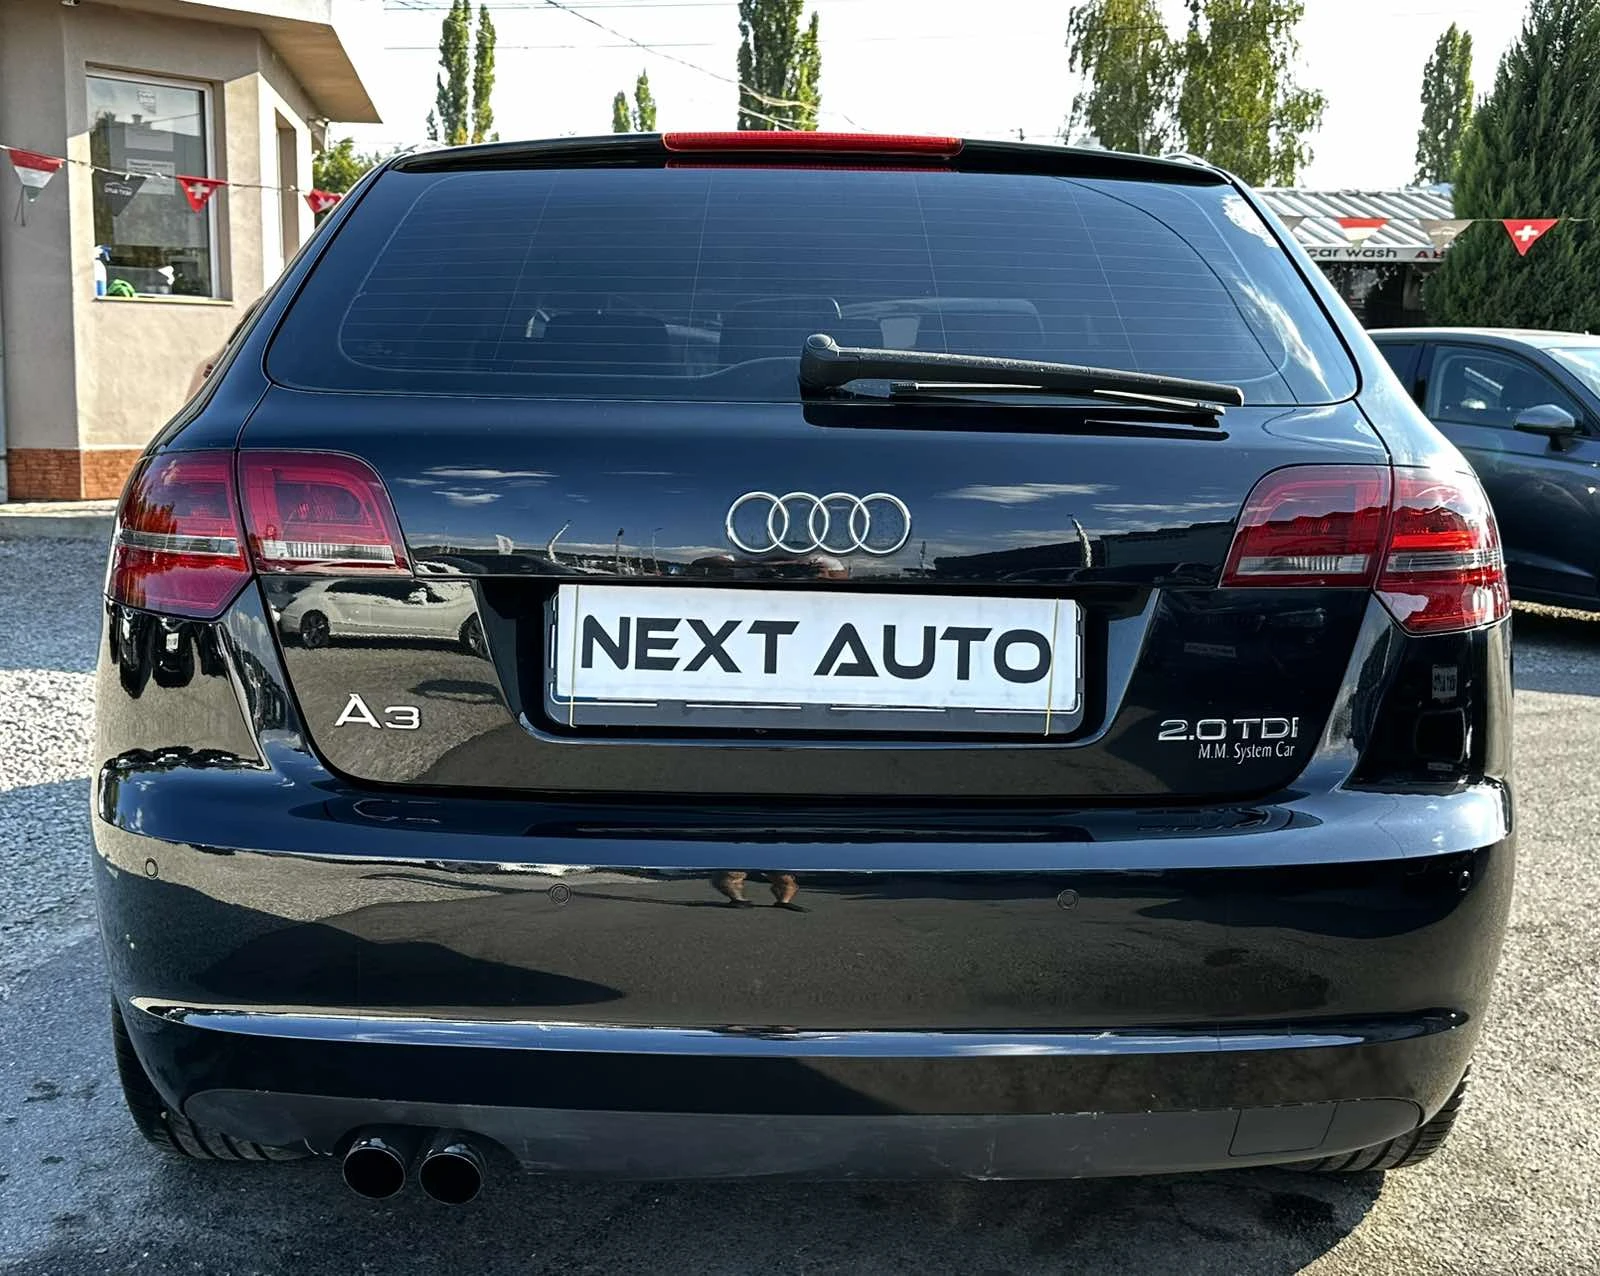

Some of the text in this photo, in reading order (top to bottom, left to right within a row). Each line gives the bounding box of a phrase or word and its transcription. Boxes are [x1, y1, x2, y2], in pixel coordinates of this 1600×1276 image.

[1307, 247, 1397, 258] car wash
[581, 614, 1053, 684] NEXT AUTO
[334, 693, 420, 729] A3
[1158, 717, 1299, 740] 2.0 TDI
[1198, 741, 1295, 764] M.M. System Car
